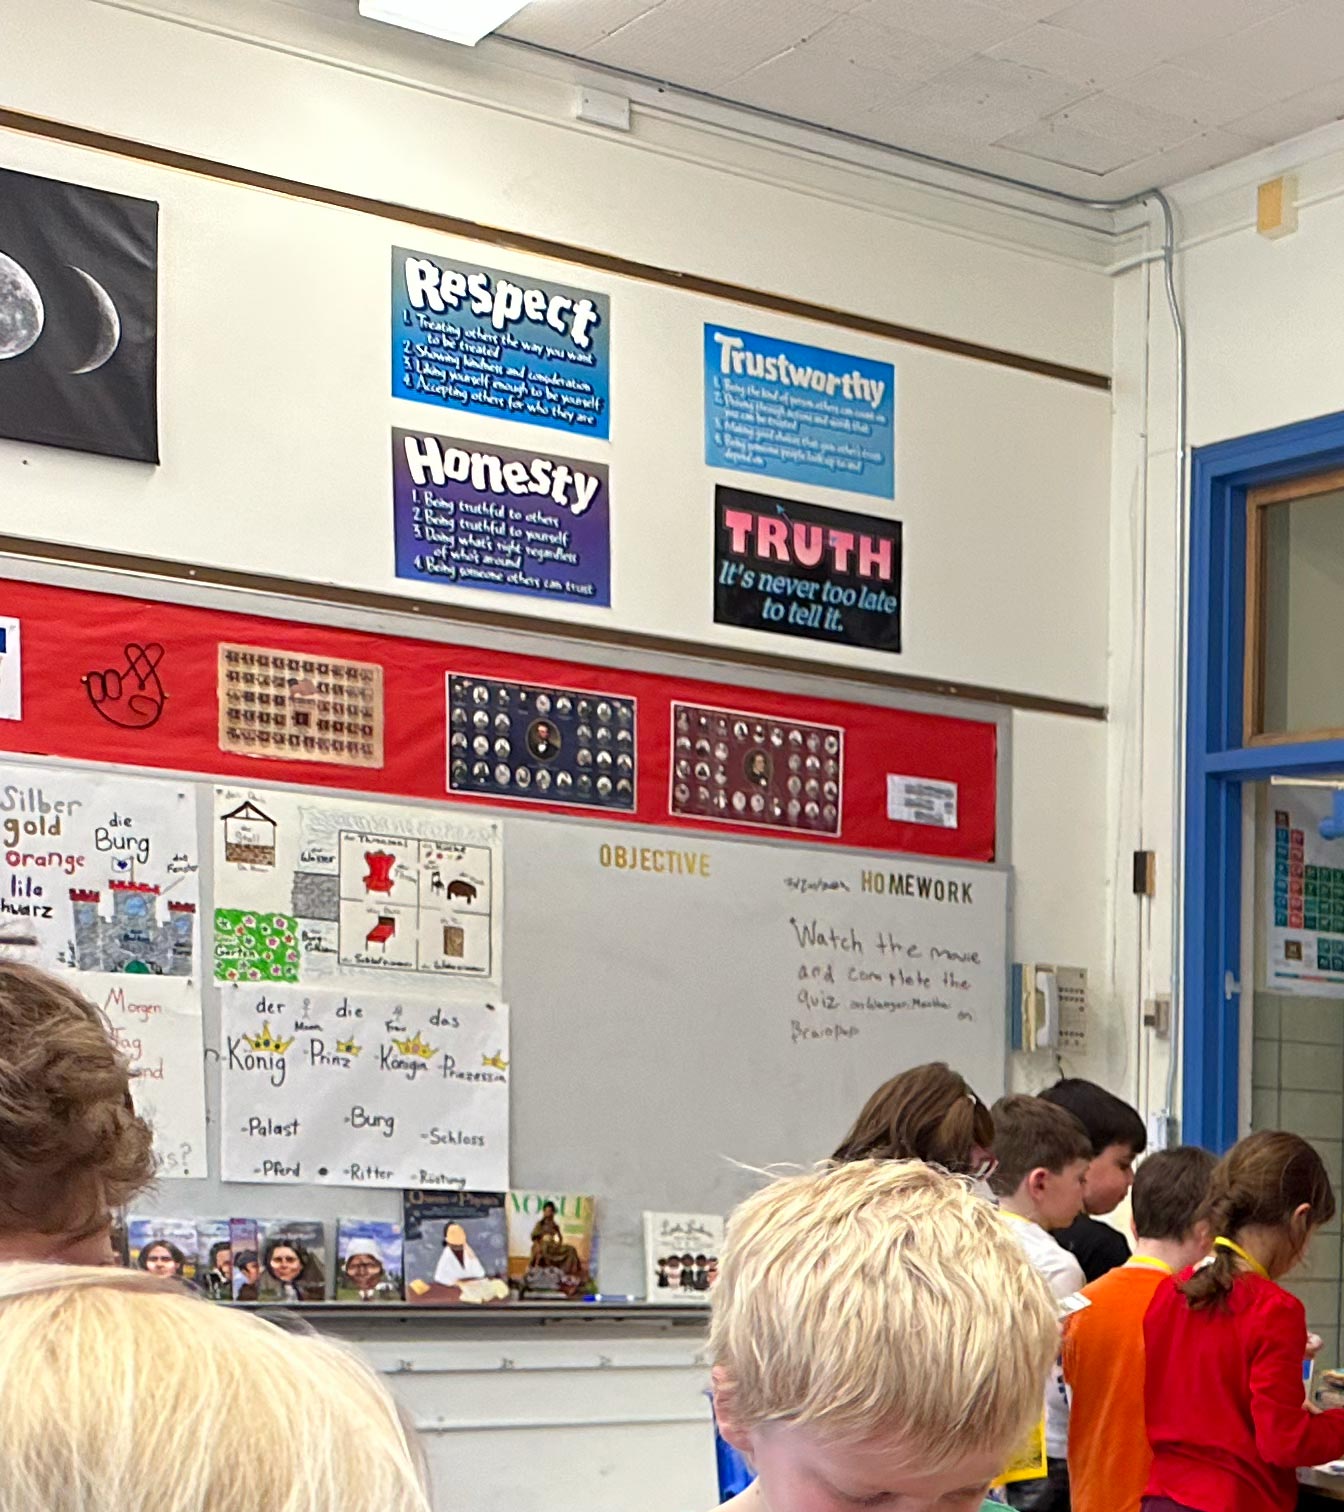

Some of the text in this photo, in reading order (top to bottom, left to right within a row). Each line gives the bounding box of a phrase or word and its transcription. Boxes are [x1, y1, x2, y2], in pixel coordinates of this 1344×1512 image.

[405, 257, 597, 348] Respect
[714, 332, 885, 409] Trustworthy
[416, 376, 468, 404] Accepting
[471, 390, 504, 408] others
[508, 397, 524, 411] for
[527, 401, 548, 415] who
[552, 405, 574, 424] they
[405, 436, 599, 515] Honesty
[424, 491, 454, 513] Being
[459, 500, 505, 519] truthful
[510, 508, 522, 520] to
[525, 512, 560, 528] others
[424, 509, 455, 531] Being
[460, 517, 505, 536] truthful
[510, 525, 522, 537] to
[526, 529, 568, 548] yourself
[724, 508, 892, 580] TRUTH
[719, 560, 897, 613] It's never too late
[762, 597, 843, 632] to tell it.
[1, 786, 83, 816] Silber
[3, 815, 62, 848] gold
[109, 812, 133, 828] die
[95, 827, 150, 865] Burg
[600, 844, 711, 877] OBJECTIVE
[861, 870, 974, 904] HOMEWORK
[790, 918, 863, 954] Watch
[877, 932, 922, 961] the
[799, 963, 970, 990] and complete the
[104, 987, 162, 1023] Morgen
[256, 996, 286, 1014] der
[336, 997, 363, 1018] die
[429, 1008, 460, 1028] das
